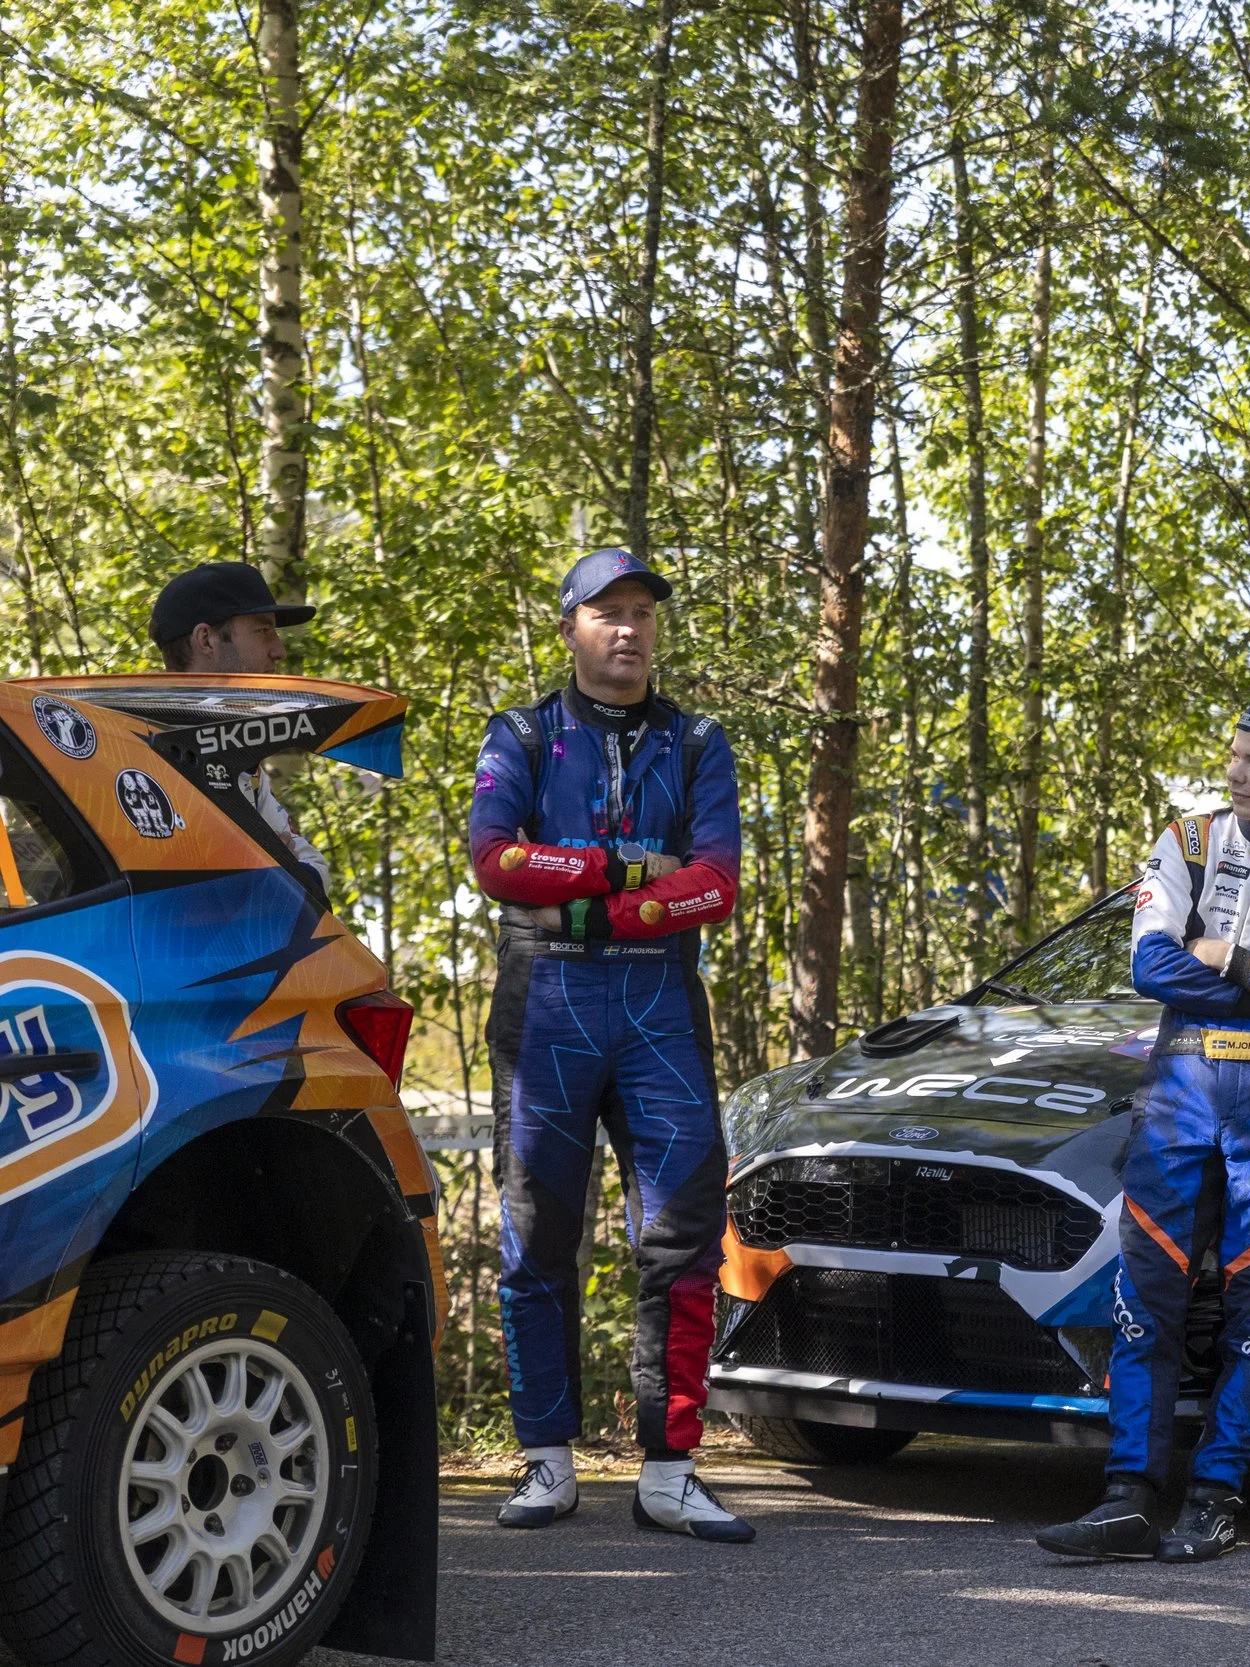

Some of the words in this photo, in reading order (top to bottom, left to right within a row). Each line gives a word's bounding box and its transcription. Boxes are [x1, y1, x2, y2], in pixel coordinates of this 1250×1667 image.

[593, 704, 627, 717] sparco
[1184, 820, 1200, 855] sparco
[530, 852, 565, 863] Crown
[569, 857, 585, 868] Oil
[668, 896, 702, 910] Crown
[704, 889, 721, 900] Oil
[550, 942, 584, 952] sparco
[826, 1074, 1107, 1114] WRC2
[896, 1127, 931, 1139] Ford
[916, 1166, 954, 1181] Rally
